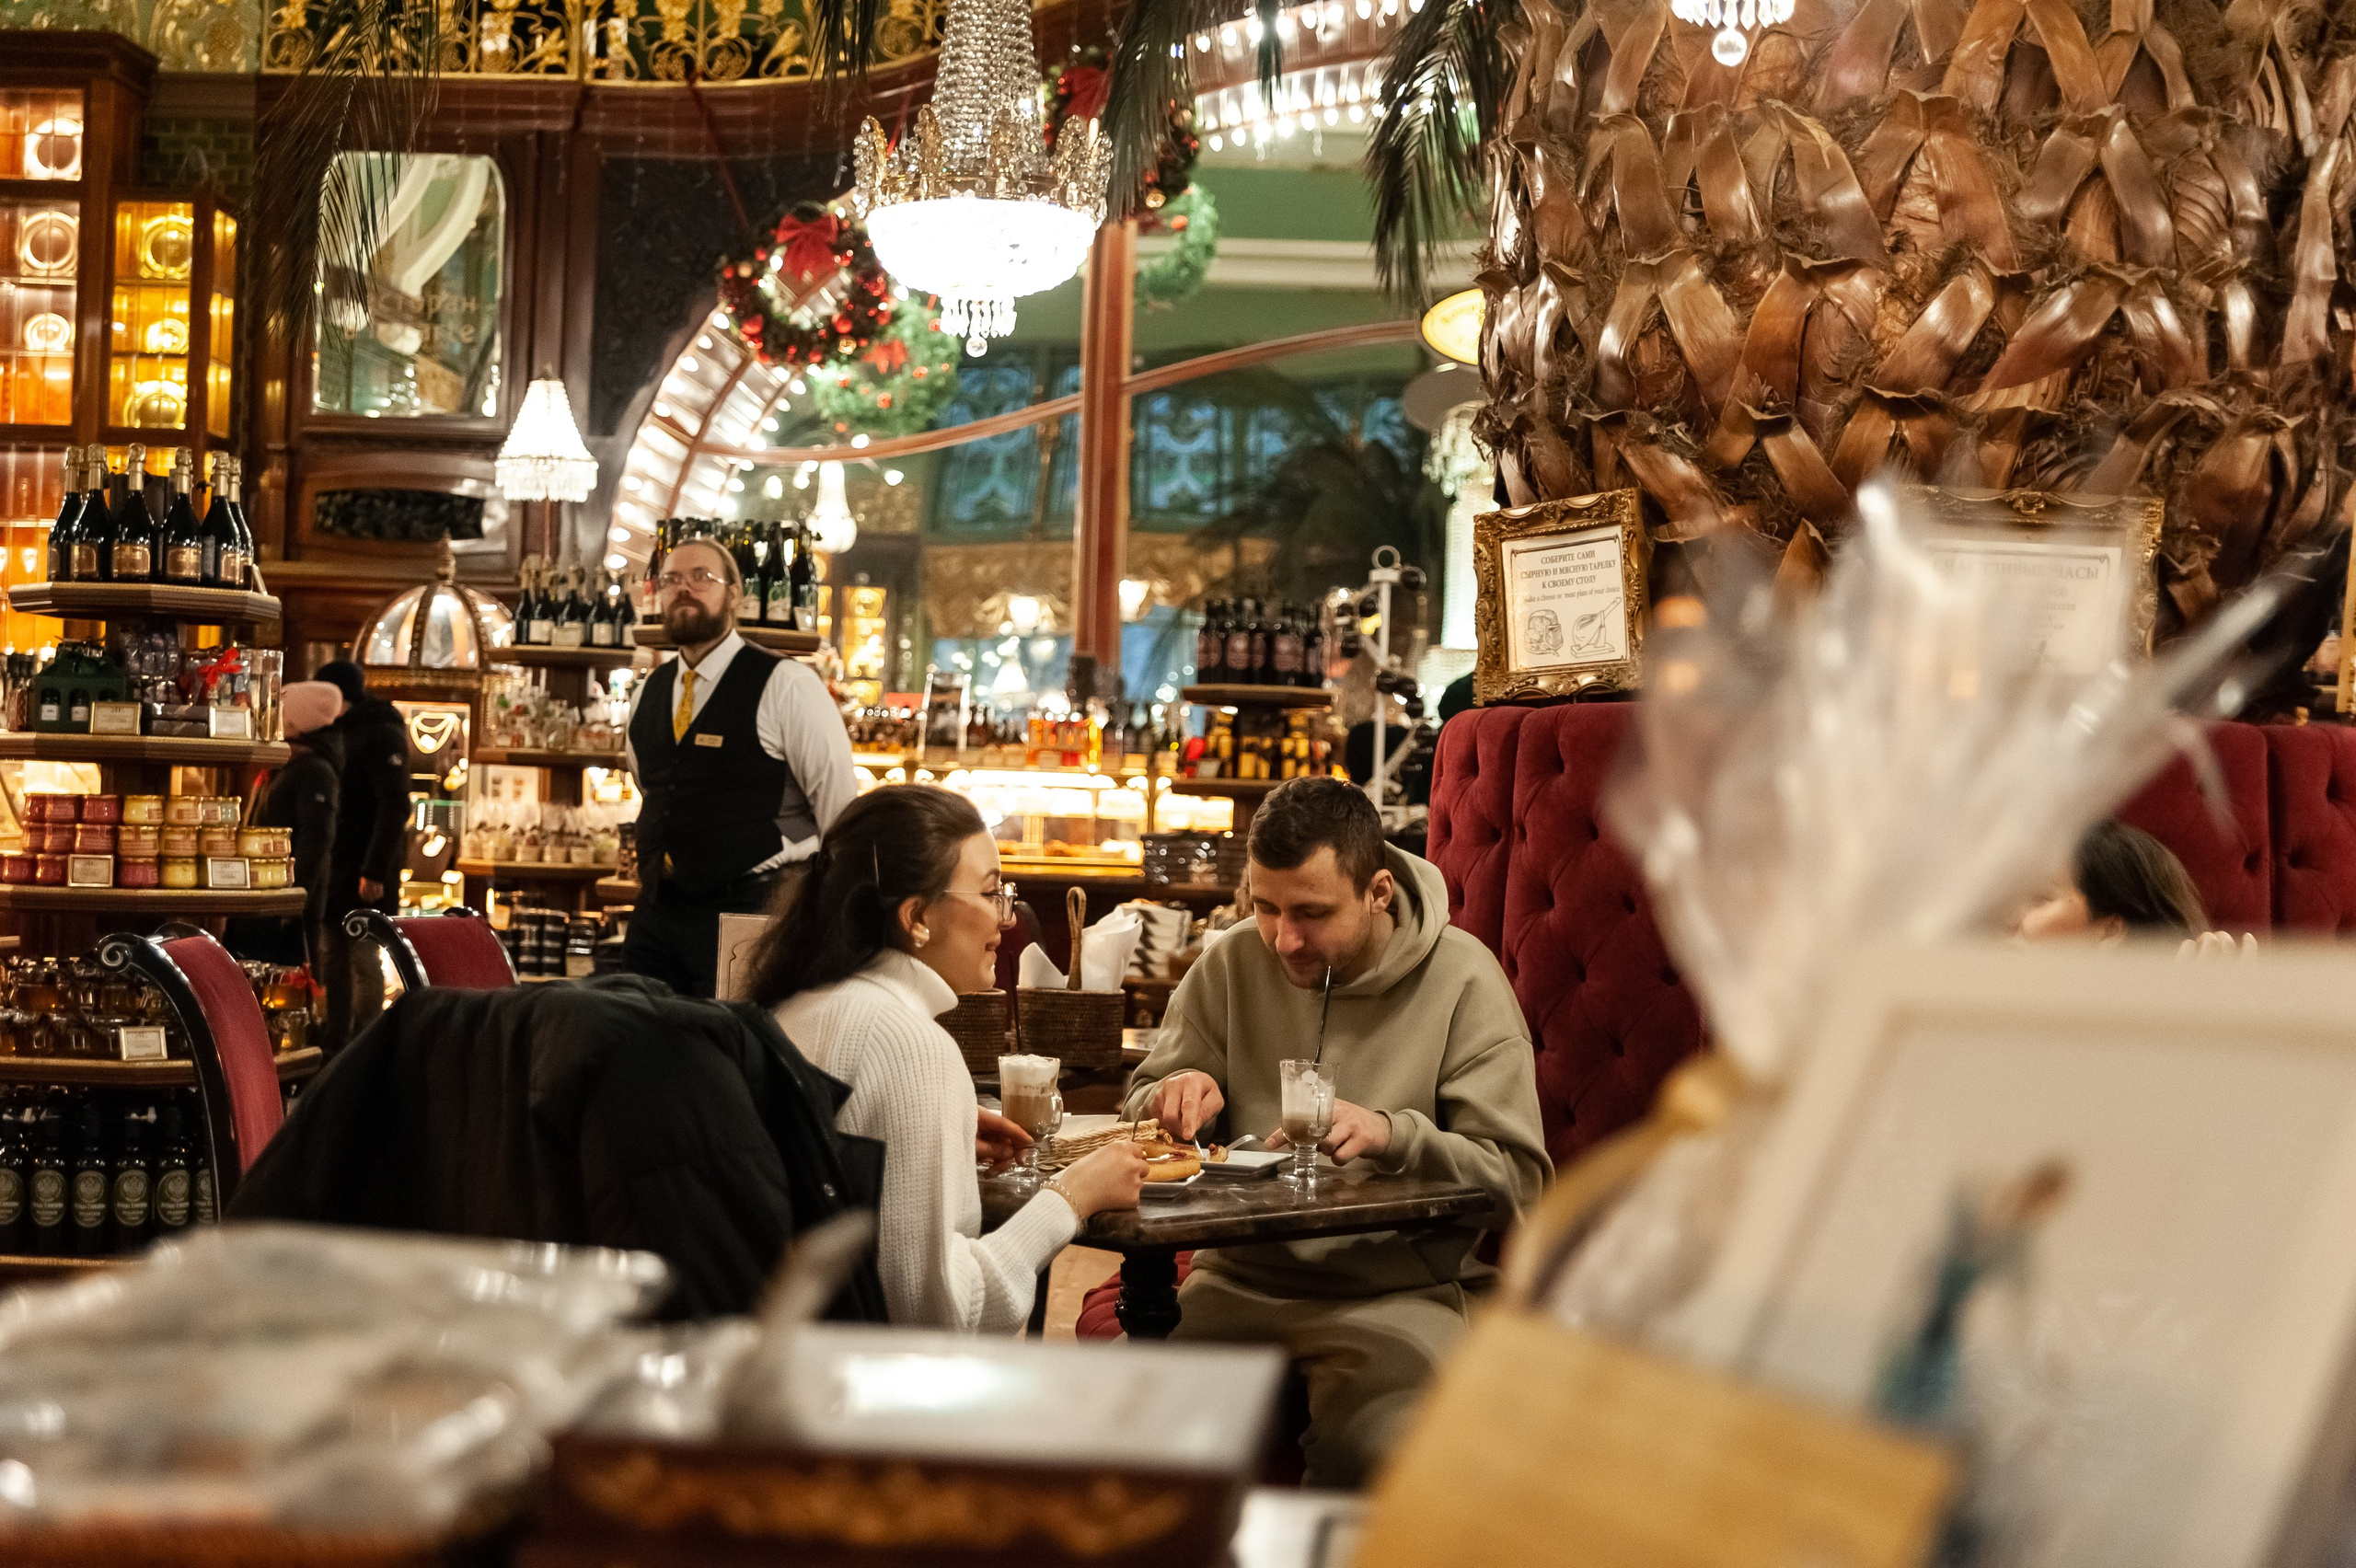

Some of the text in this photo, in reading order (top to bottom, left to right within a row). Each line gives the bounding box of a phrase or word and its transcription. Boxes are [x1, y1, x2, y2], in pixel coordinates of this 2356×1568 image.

[1541, 550, 1596, 565] СОБЕРИТЕ САМИ
[1520, 559, 1616, 580] СЫРНУЮ И МЯСНУЮ ТАРЕЛКУ
[1542, 574, 1597, 590] К СВОЕМУ СТОЛУ
